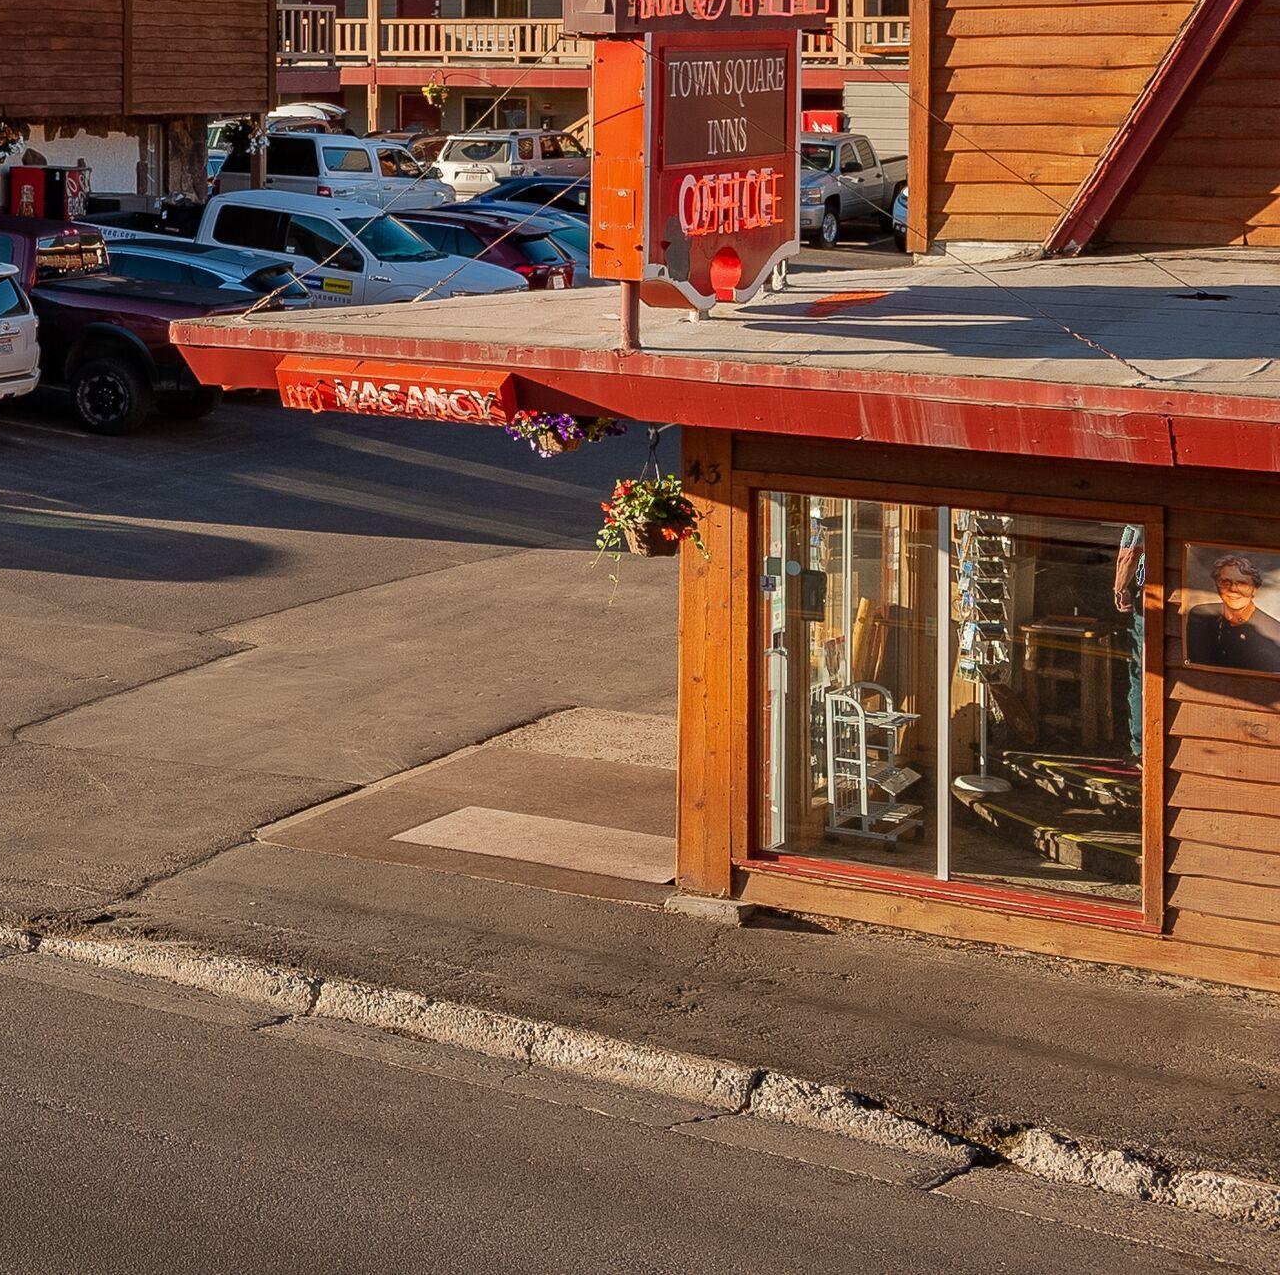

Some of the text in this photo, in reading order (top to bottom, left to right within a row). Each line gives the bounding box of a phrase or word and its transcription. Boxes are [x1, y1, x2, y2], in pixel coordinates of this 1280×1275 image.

[668, 57, 785, 107] TOWN SQUARE
[707, 116, 748, 155] INNS
[679, 167, 784, 236] OFFICE
[334, 379, 502, 421] VACANCY
